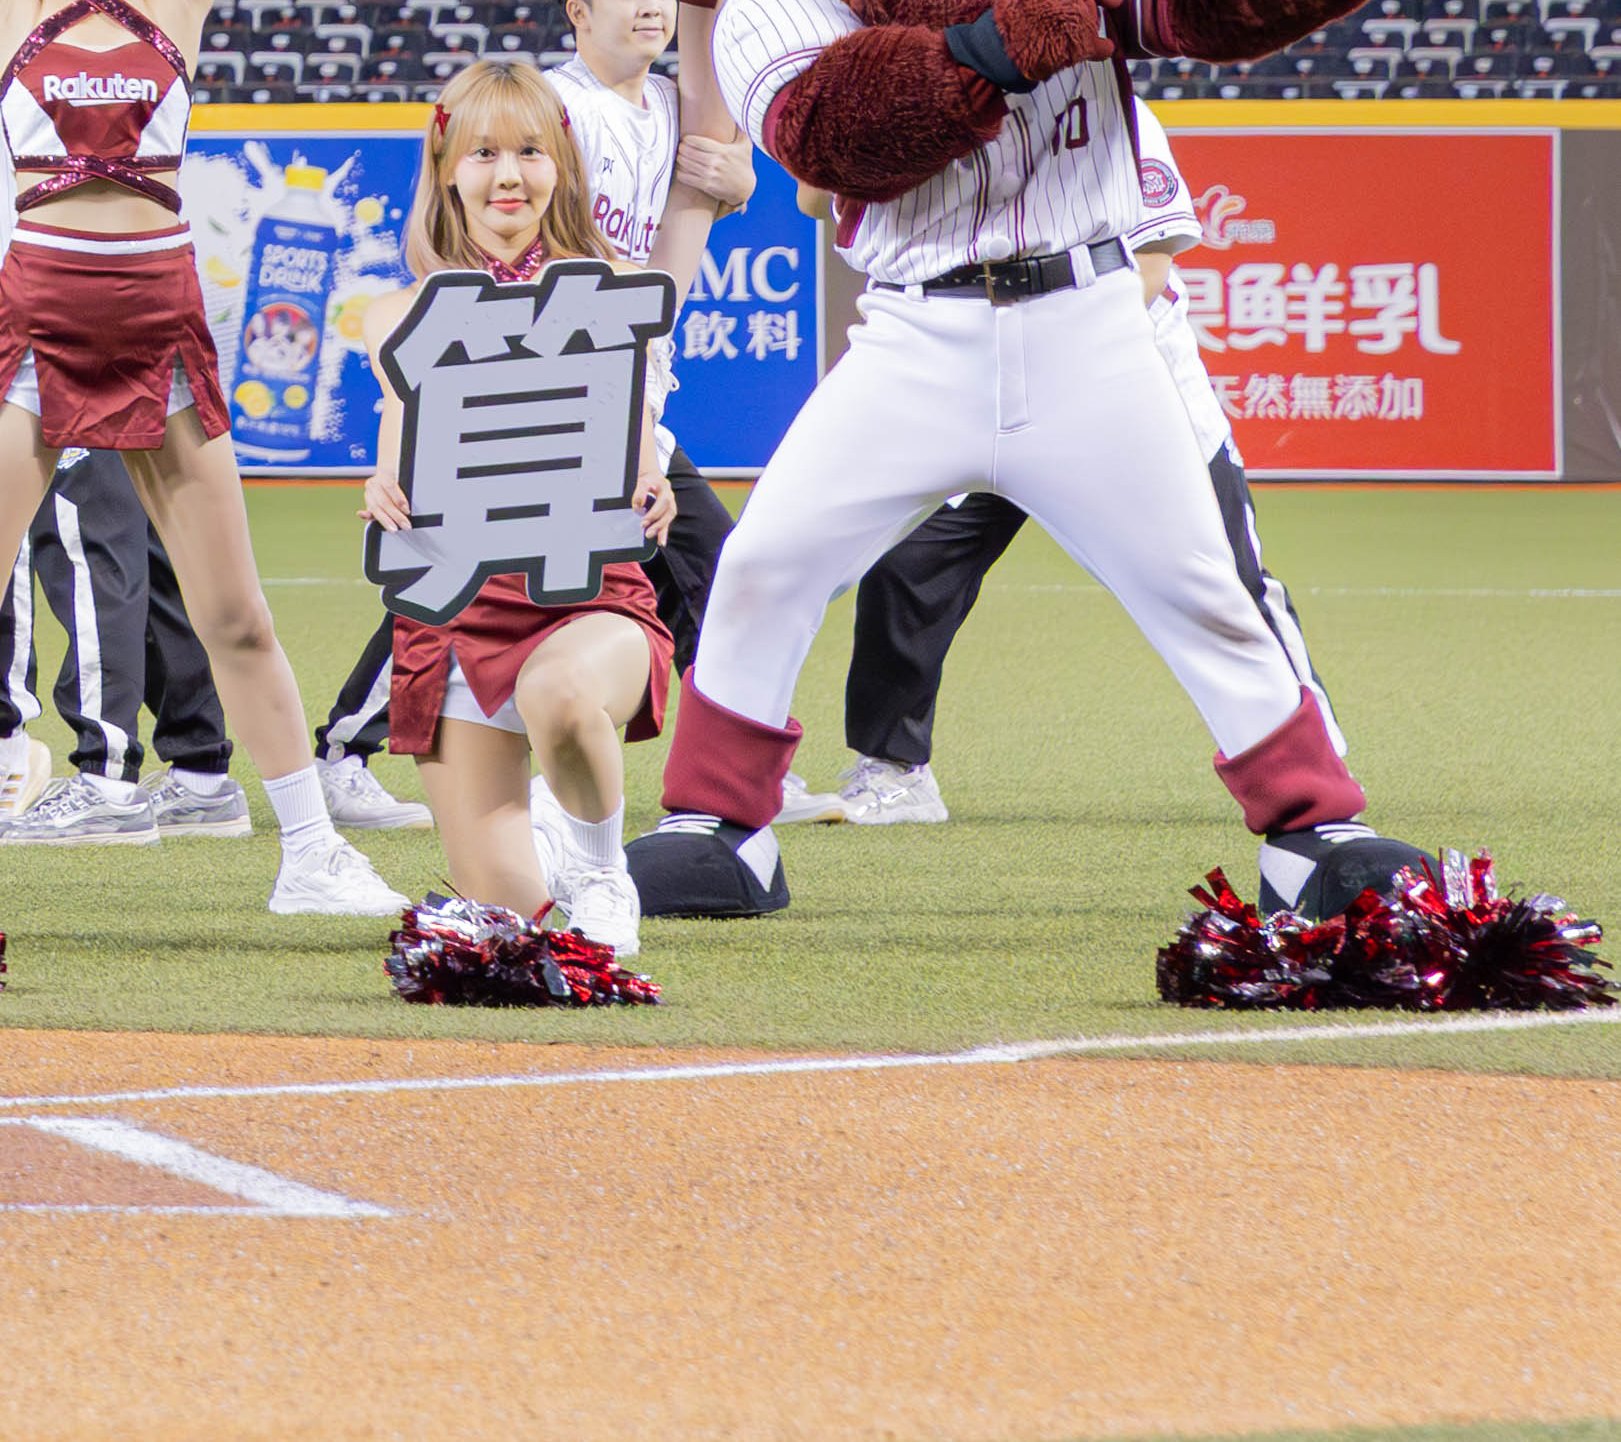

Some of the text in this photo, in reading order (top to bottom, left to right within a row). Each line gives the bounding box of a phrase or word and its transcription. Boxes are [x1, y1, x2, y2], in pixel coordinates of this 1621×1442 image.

[42, 71, 159, 108] Rakuten
[262, 244, 329, 273] SPORTS
[258, 264, 324, 294] DRINK
[681, 309, 802, 361] 飲料
[376, 271, 668, 614] 算
